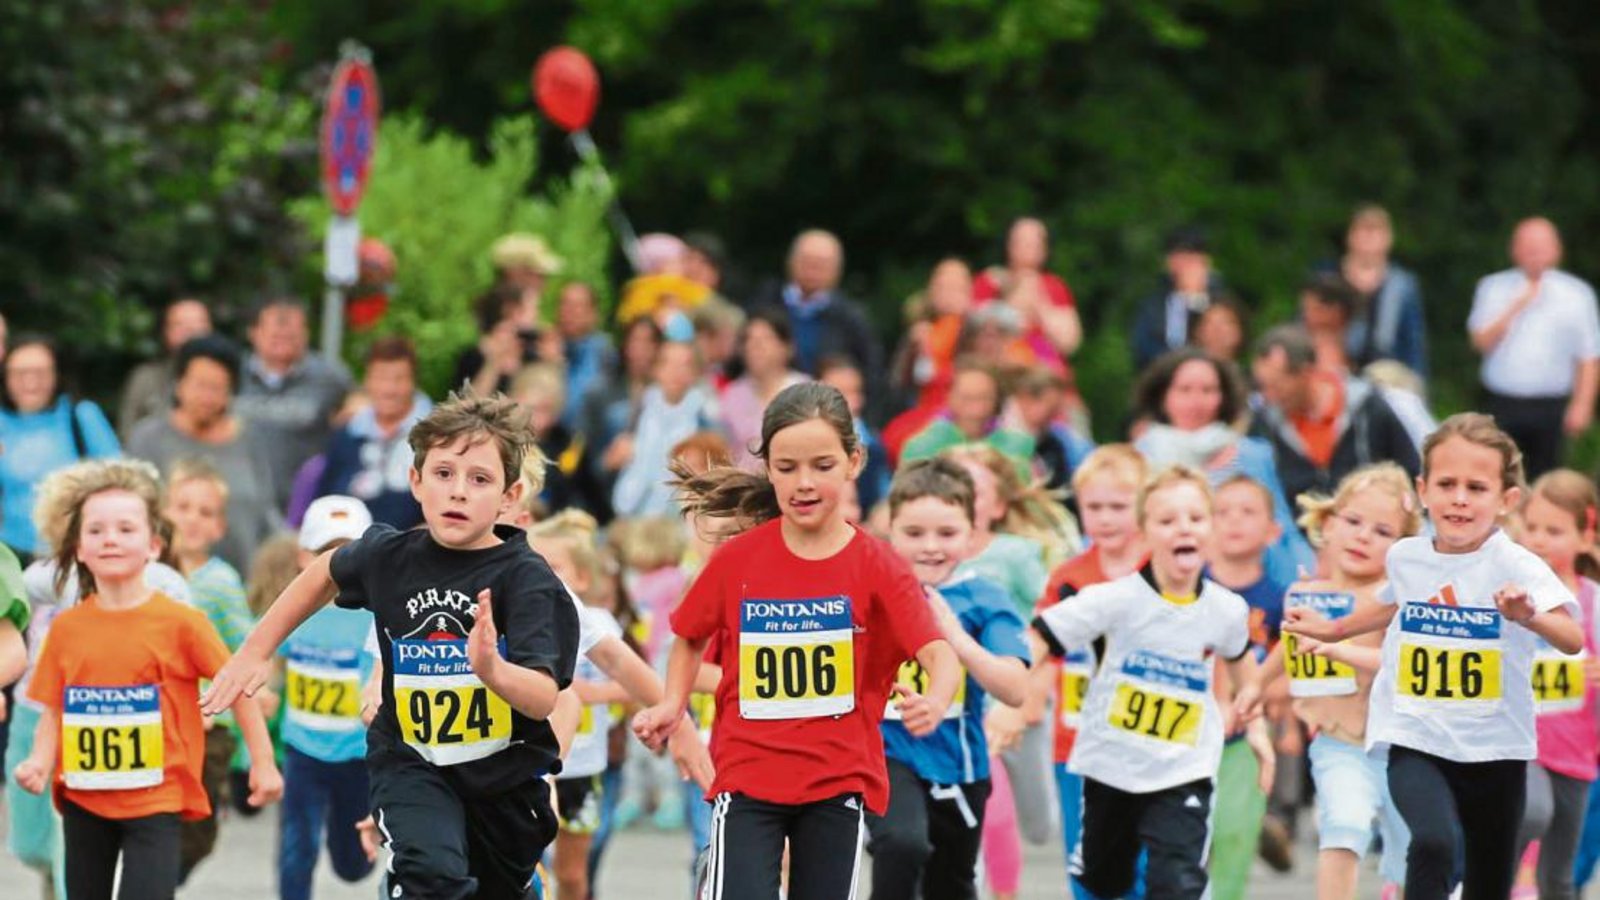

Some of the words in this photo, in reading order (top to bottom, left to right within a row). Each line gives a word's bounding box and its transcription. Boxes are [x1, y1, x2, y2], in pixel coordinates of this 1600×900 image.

[746, 600, 846, 621] FONTANIS
[1406, 605, 1495, 625] FONTANIS
[765, 621, 779, 631] Fit
[782, 621, 799, 631] for
[801, 619, 823, 630] life.
[398, 644, 469, 663] FONTA
[418, 663, 430, 673] Fit
[434, 663, 450, 673] for
[755, 645, 836, 699] 906
[1411, 647, 1483, 698] 916
[68, 686, 155, 706] FONTANIS
[410, 688, 493, 744] 924
[1123, 691, 1190, 740] 917
[78, 727, 146, 771] 961
